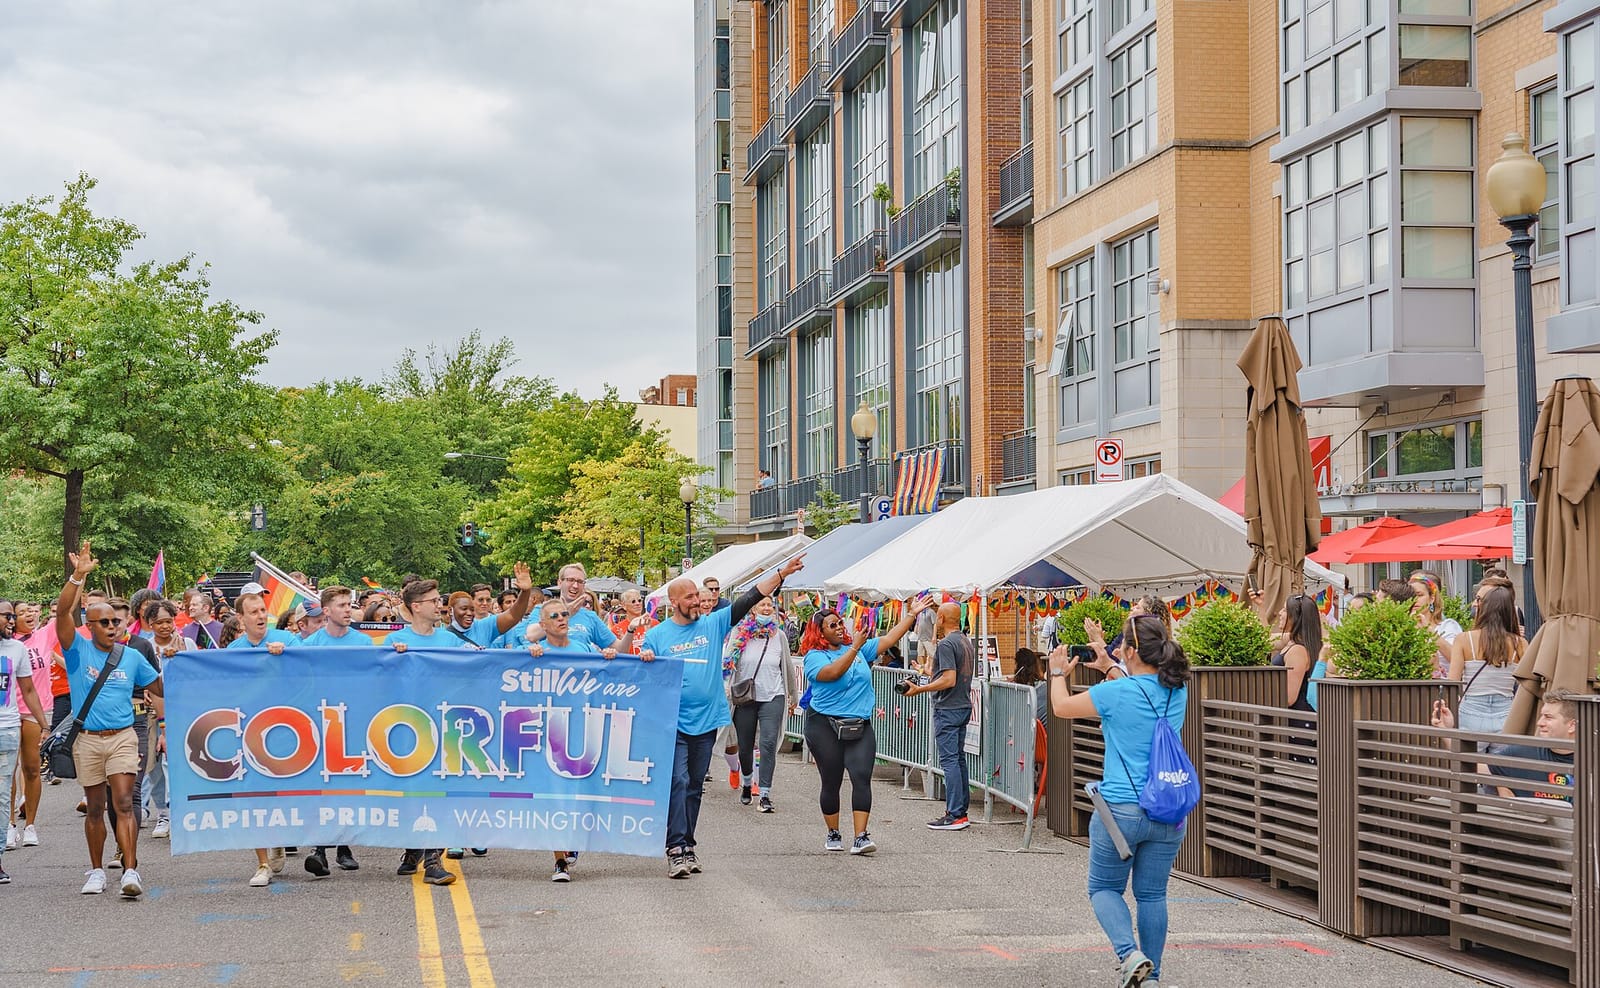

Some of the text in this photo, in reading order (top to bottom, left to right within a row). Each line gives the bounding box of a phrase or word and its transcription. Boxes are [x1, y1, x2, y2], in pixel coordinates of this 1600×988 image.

[602, 682, 641, 698] are
[184, 696, 655, 786] COLORFUL
[183, 807, 655, 836] CAPITAL PRIDE WASHINGTON DC
